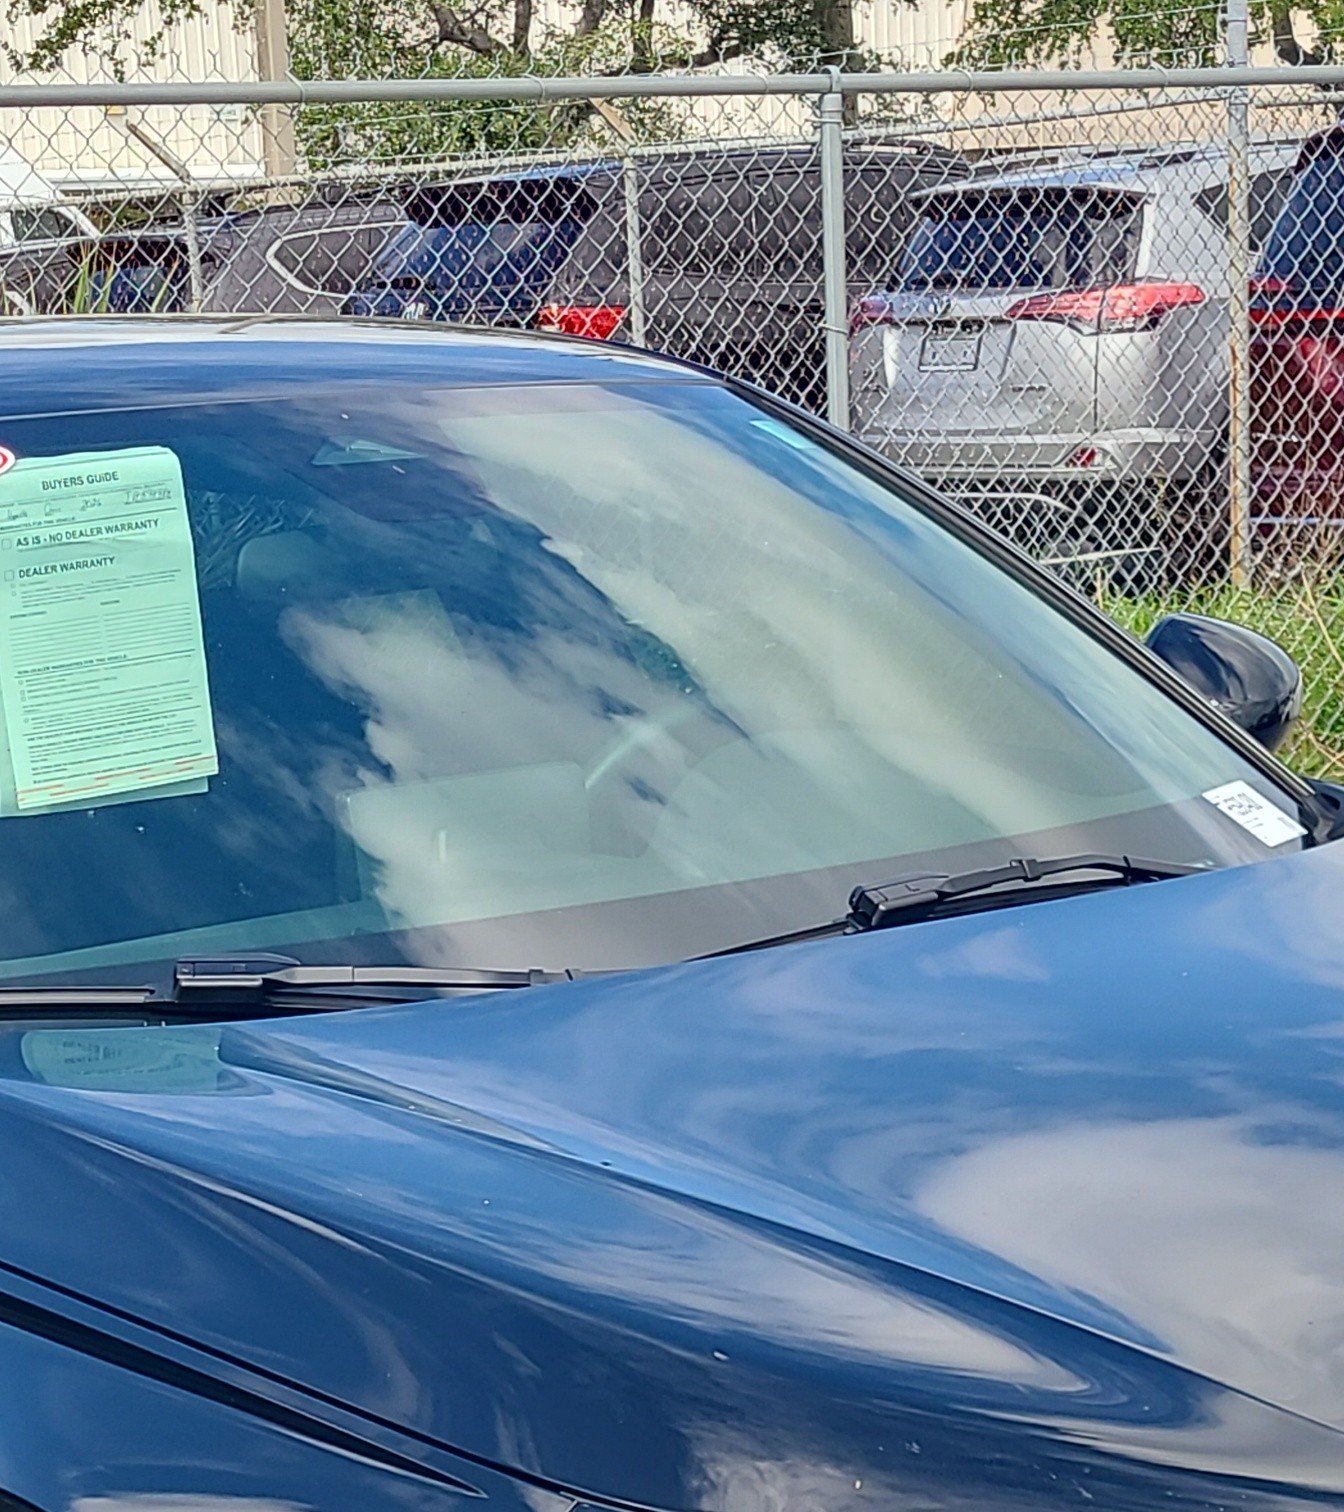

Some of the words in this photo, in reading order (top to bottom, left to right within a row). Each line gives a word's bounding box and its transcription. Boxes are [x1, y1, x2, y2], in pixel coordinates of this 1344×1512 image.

[41, 473, 85, 491] BUYERS
[86, 470, 119, 486] GUIDE
[16, 537, 29, 547] AS
[32, 535, 41, 545] IS
[49, 532, 63, 542] NO
[65, 526, 103, 541] DEALER
[104, 518, 160, 534] WARRANTY
[18, 564, 58, 580] DEALER
[59, 556, 116, 573] WARRANTY
